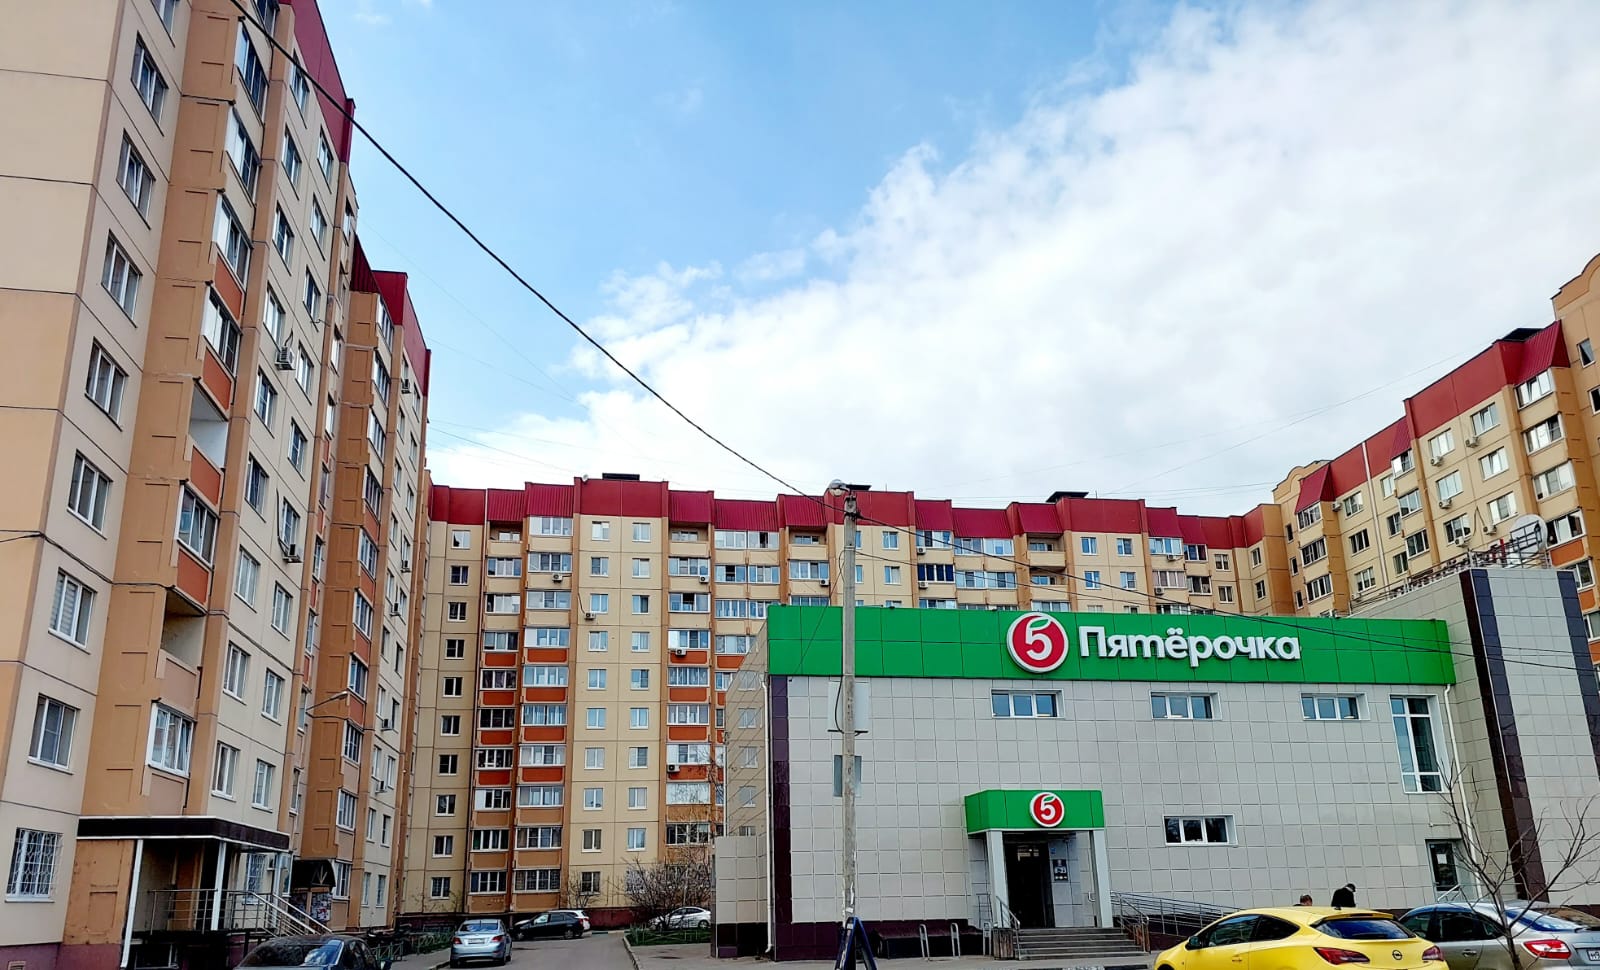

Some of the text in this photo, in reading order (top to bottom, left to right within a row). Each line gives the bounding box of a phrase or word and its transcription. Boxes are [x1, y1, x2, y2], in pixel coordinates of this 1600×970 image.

[1025, 618, 1301, 668] 5 Пятёрочка
[1040, 794, 1056, 820] 5
